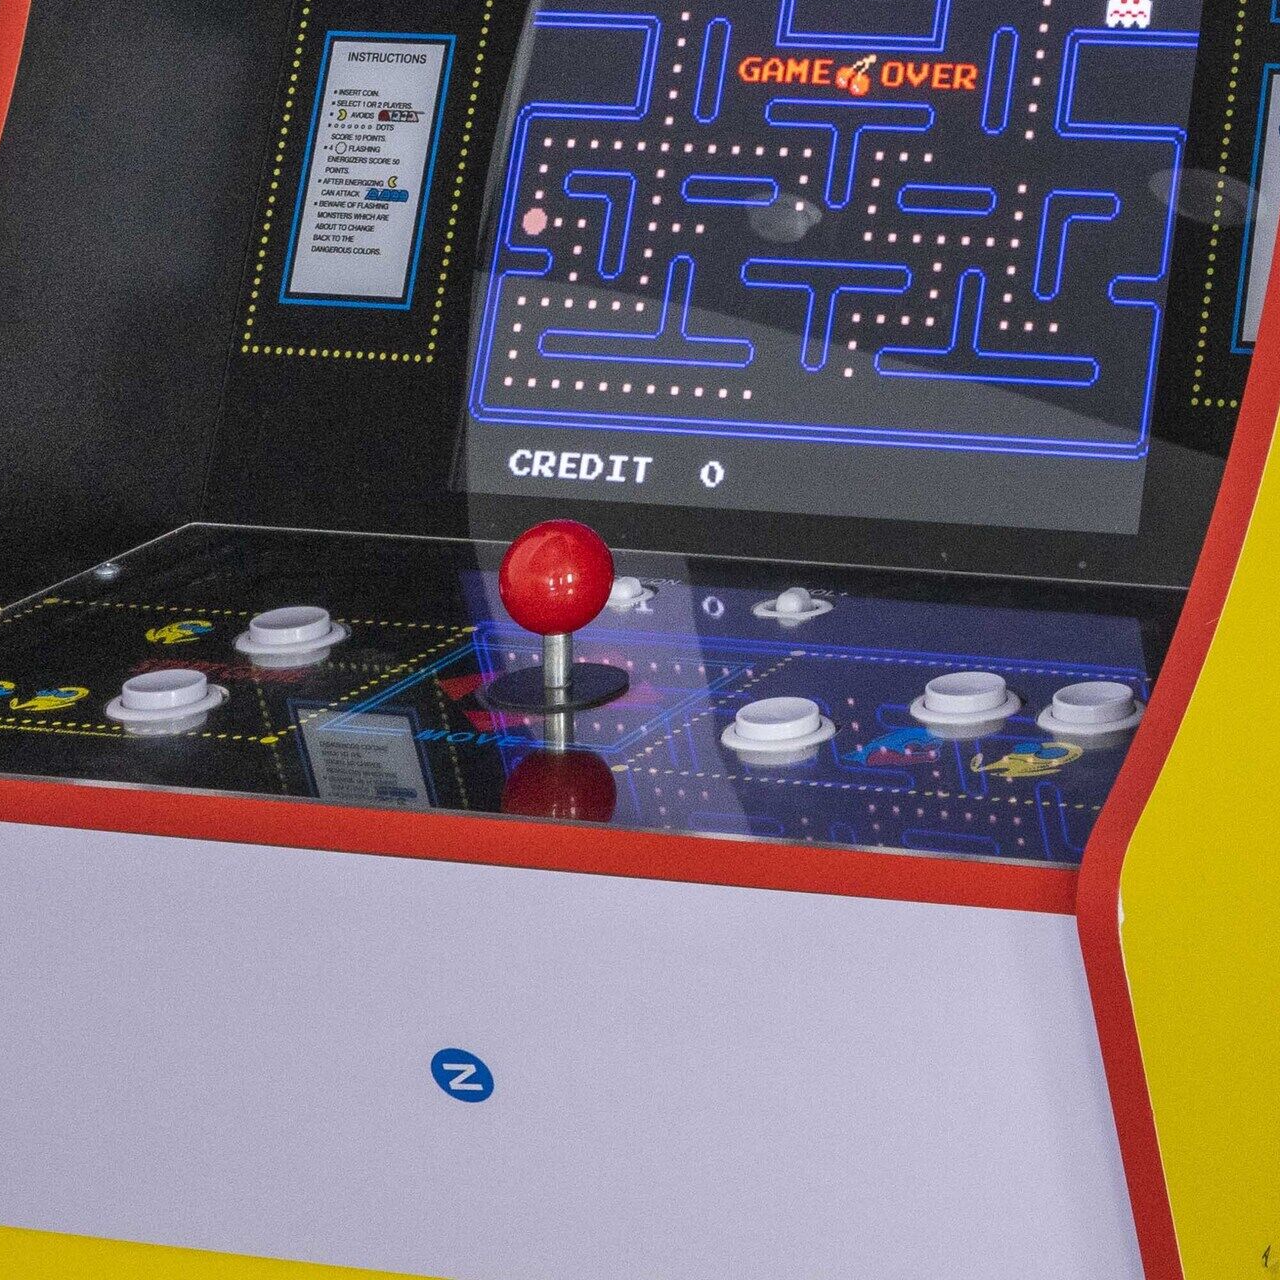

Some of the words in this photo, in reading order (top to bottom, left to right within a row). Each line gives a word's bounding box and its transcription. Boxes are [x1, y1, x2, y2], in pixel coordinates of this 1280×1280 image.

[347, 51, 427, 64] INSTRUCTIONS
[738, 55, 835, 84] GAME
[880, 61, 979, 90] OVER
[348, 145, 381, 153] FLASHING
[368, 157, 391, 165] SCORE
[357, 202, 389, 210] FLASHING
[317, 212, 353, 220] MONSTERS
[348, 224, 375, 232] CHANGE
[311, 246, 352, 254] DANGEROUS
[508, 449, 654, 484] CREDIT
[699, 460, 725, 488] 0
